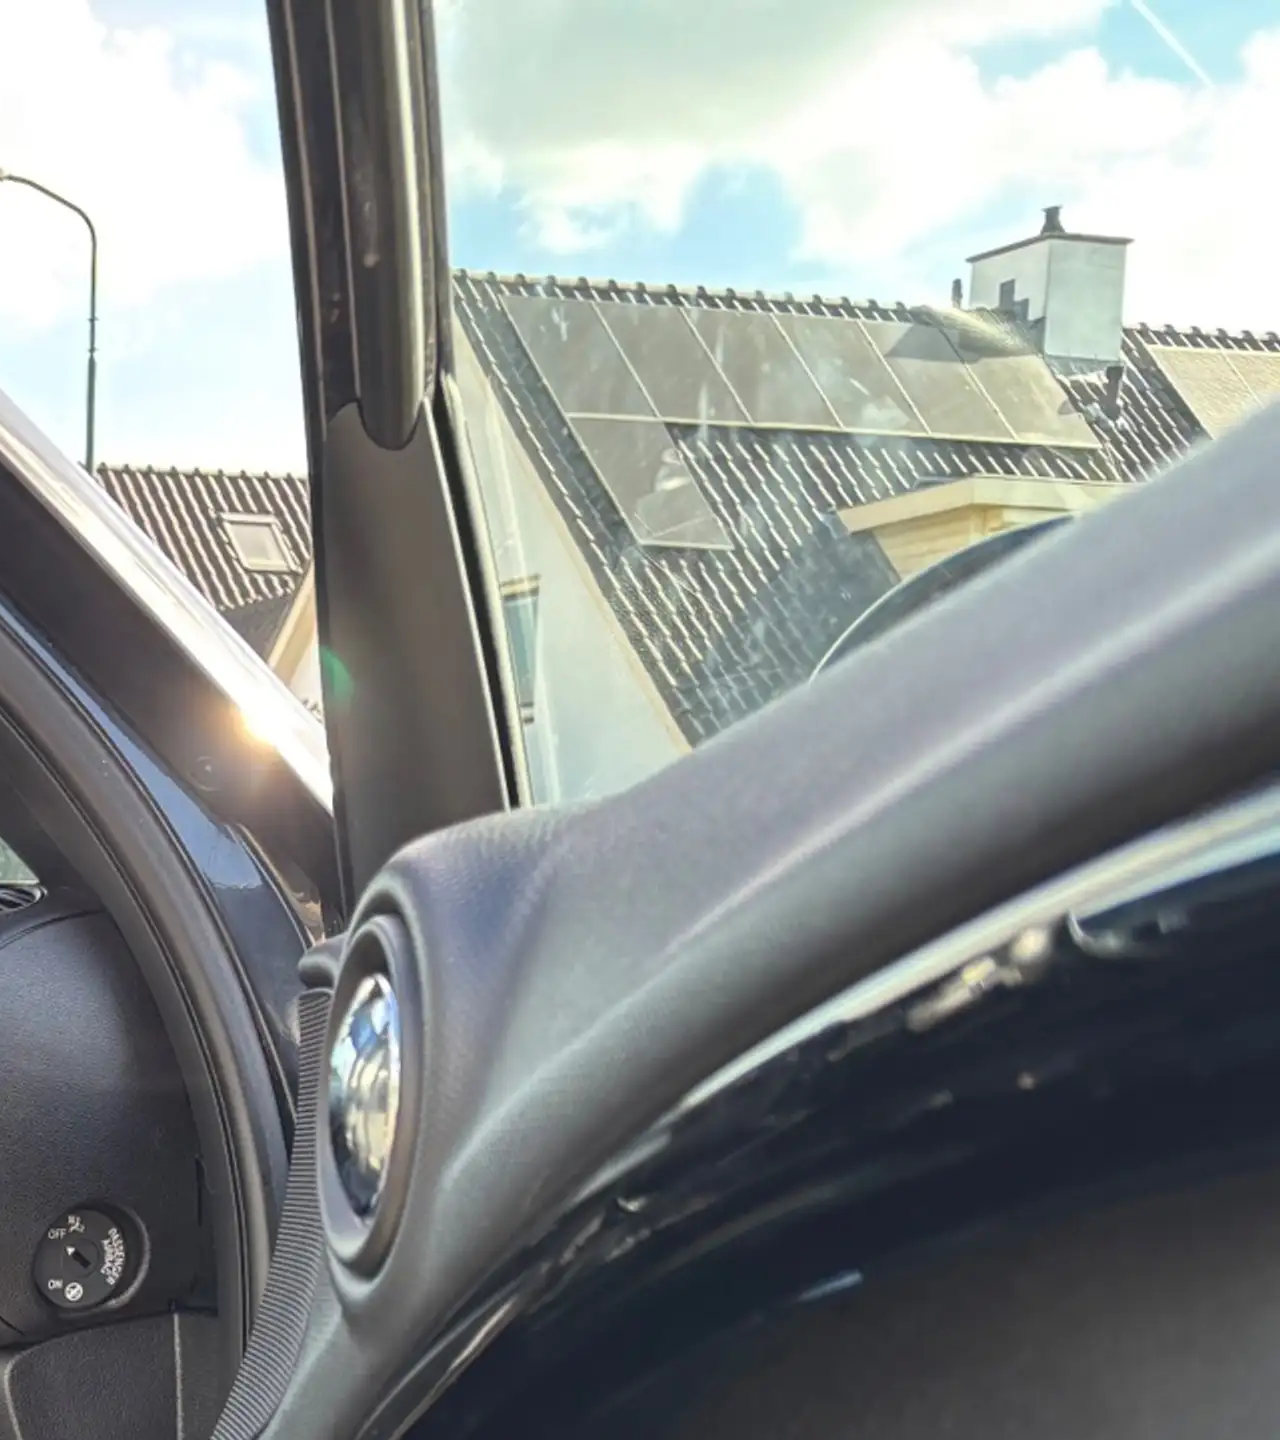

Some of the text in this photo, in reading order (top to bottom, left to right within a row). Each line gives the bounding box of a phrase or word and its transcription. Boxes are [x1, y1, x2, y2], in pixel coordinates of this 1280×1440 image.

[47, 1228, 66, 1239] OFF
[106, 1227, 125, 1285] PASSENGER
[47, 1279, 63, 1290] ON
